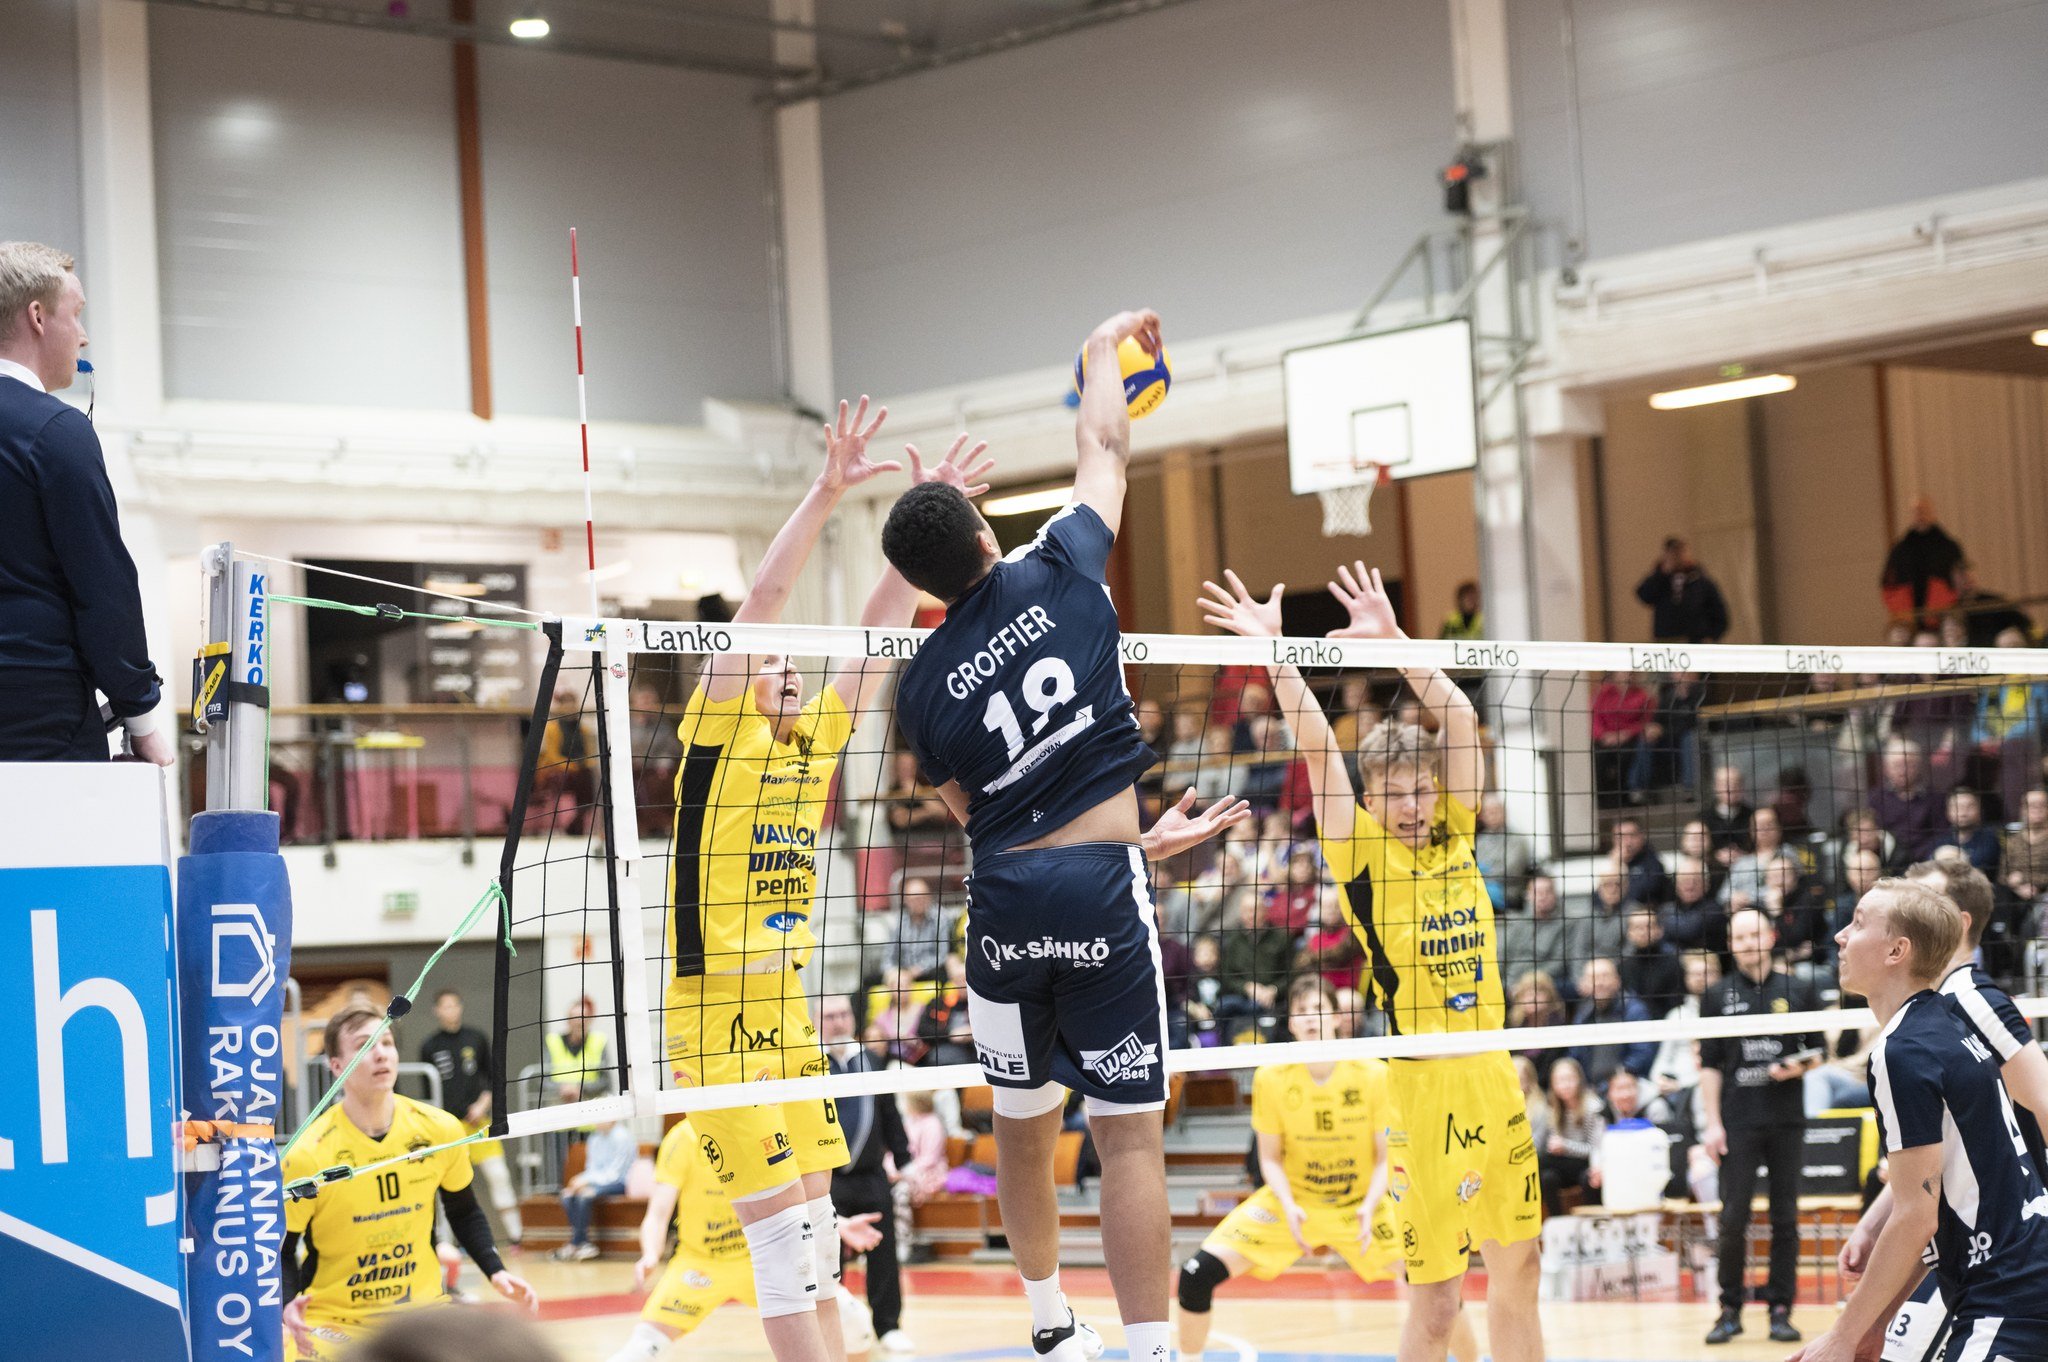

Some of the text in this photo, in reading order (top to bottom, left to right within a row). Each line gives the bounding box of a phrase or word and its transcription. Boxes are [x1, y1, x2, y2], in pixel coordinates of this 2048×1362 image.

[247, 574, 265, 687] KERKO
[642, 623, 732, 652] Lanko
[865, 630, 924, 658] Lan
[946, 605, 1057, 700] GROFFIER
[1272, 640, 1343, 665] Lanko
[1454, 643, 1519, 667] Lanko
[1630, 647, 1692, 671] Lanko
[1786, 649, 1844, 673] Lanko
[1936, 651, 1991, 674] Lanko
[1001, 936, 1110, 961] K-SÄHKÖ
[1097, 1038, 1142, 1079] Well
[1121, 1064, 1150, 1081] Beef
[1314, 1110, 1335, 1132] 16
[208, 1025, 254, 1358] RAKNNUS OY
[375, 1171, 400, 1203] 10
[1524, 1172, 1538, 1203] 11
